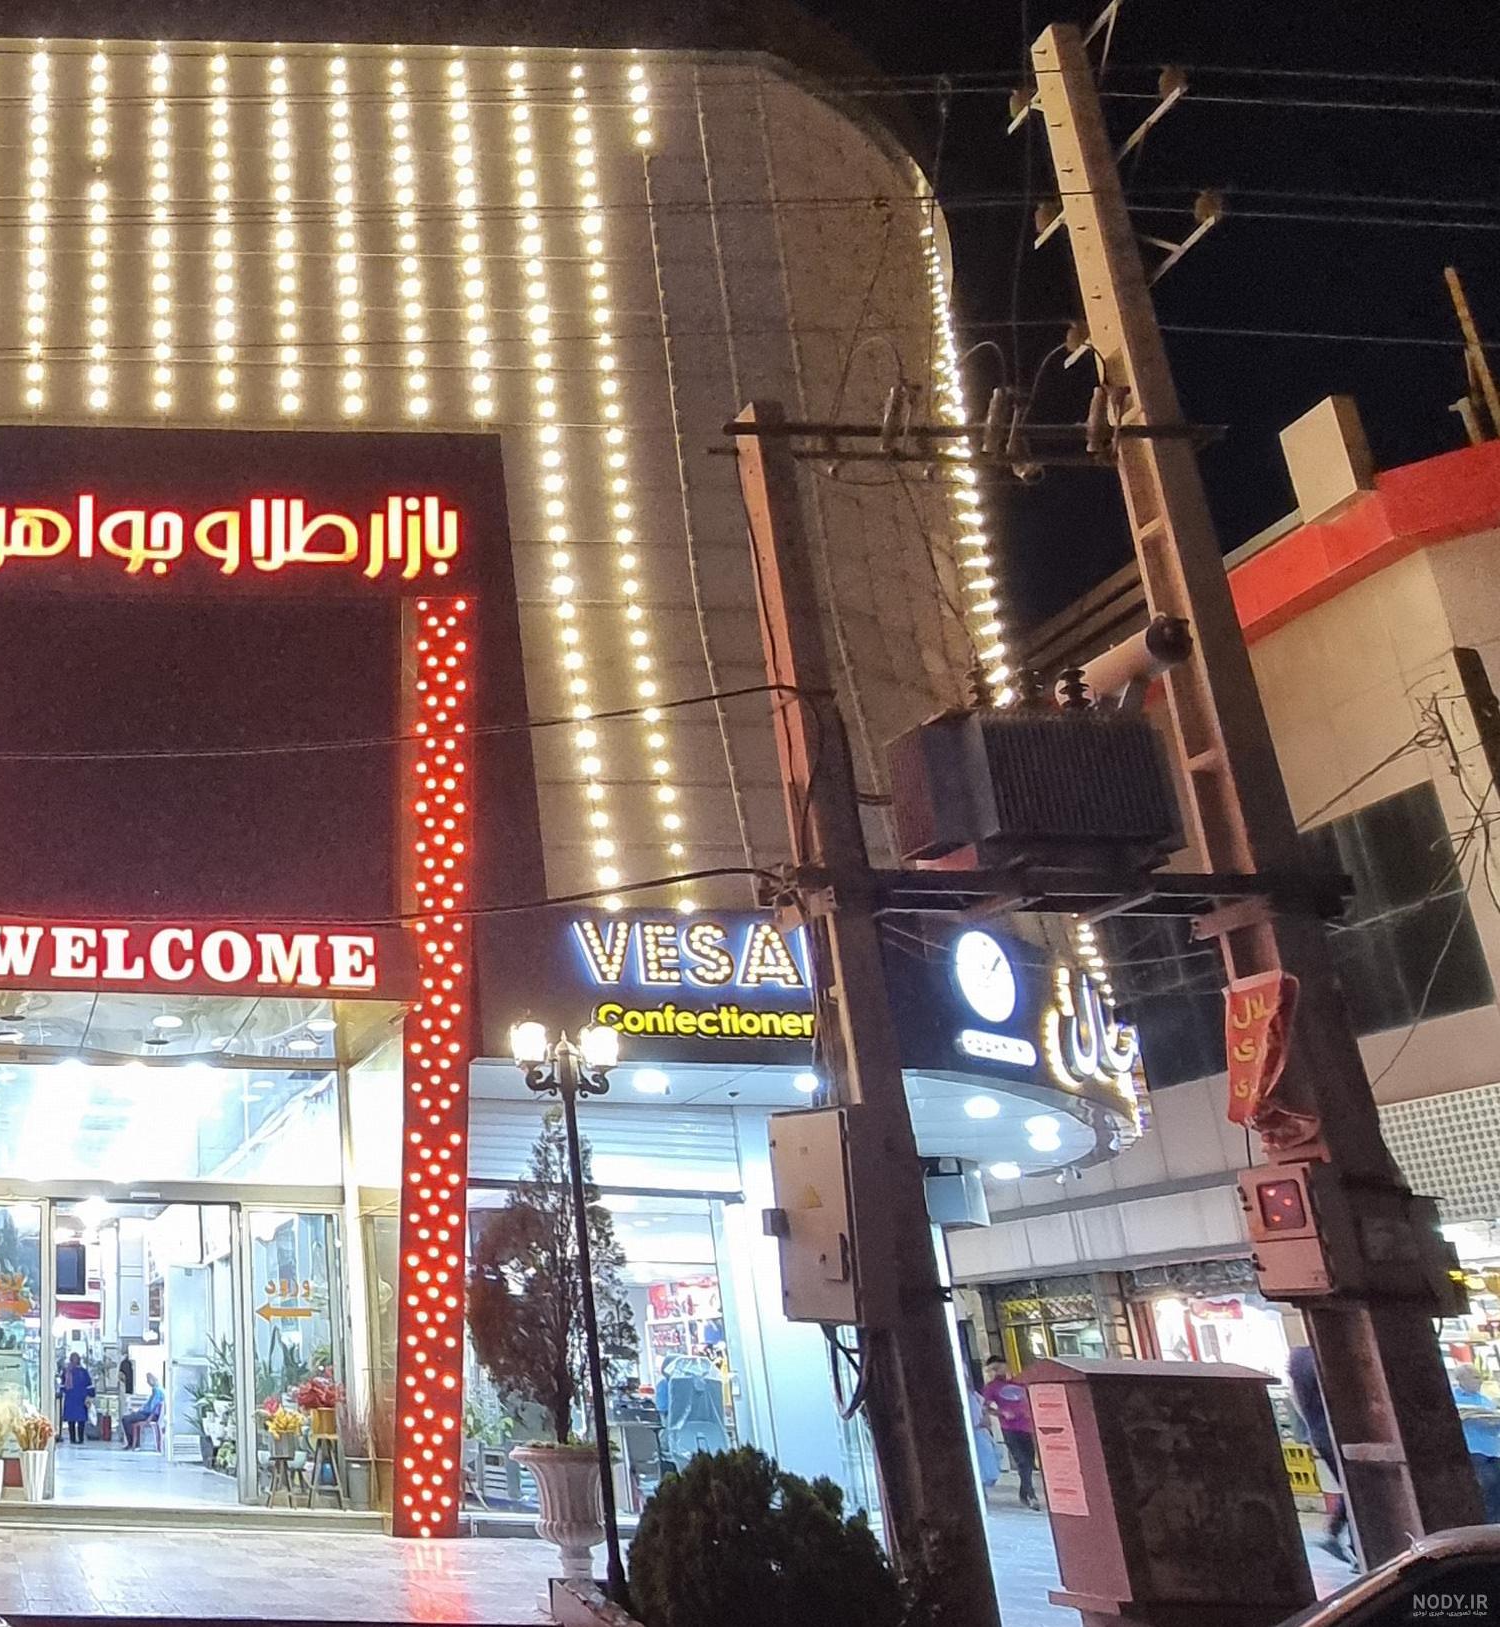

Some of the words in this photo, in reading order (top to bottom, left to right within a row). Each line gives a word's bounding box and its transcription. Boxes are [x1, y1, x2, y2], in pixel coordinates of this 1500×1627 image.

[195, 510, 240, 575] و
[249, 497, 359, 572] طلا
[363, 495, 458, 579] بازار
